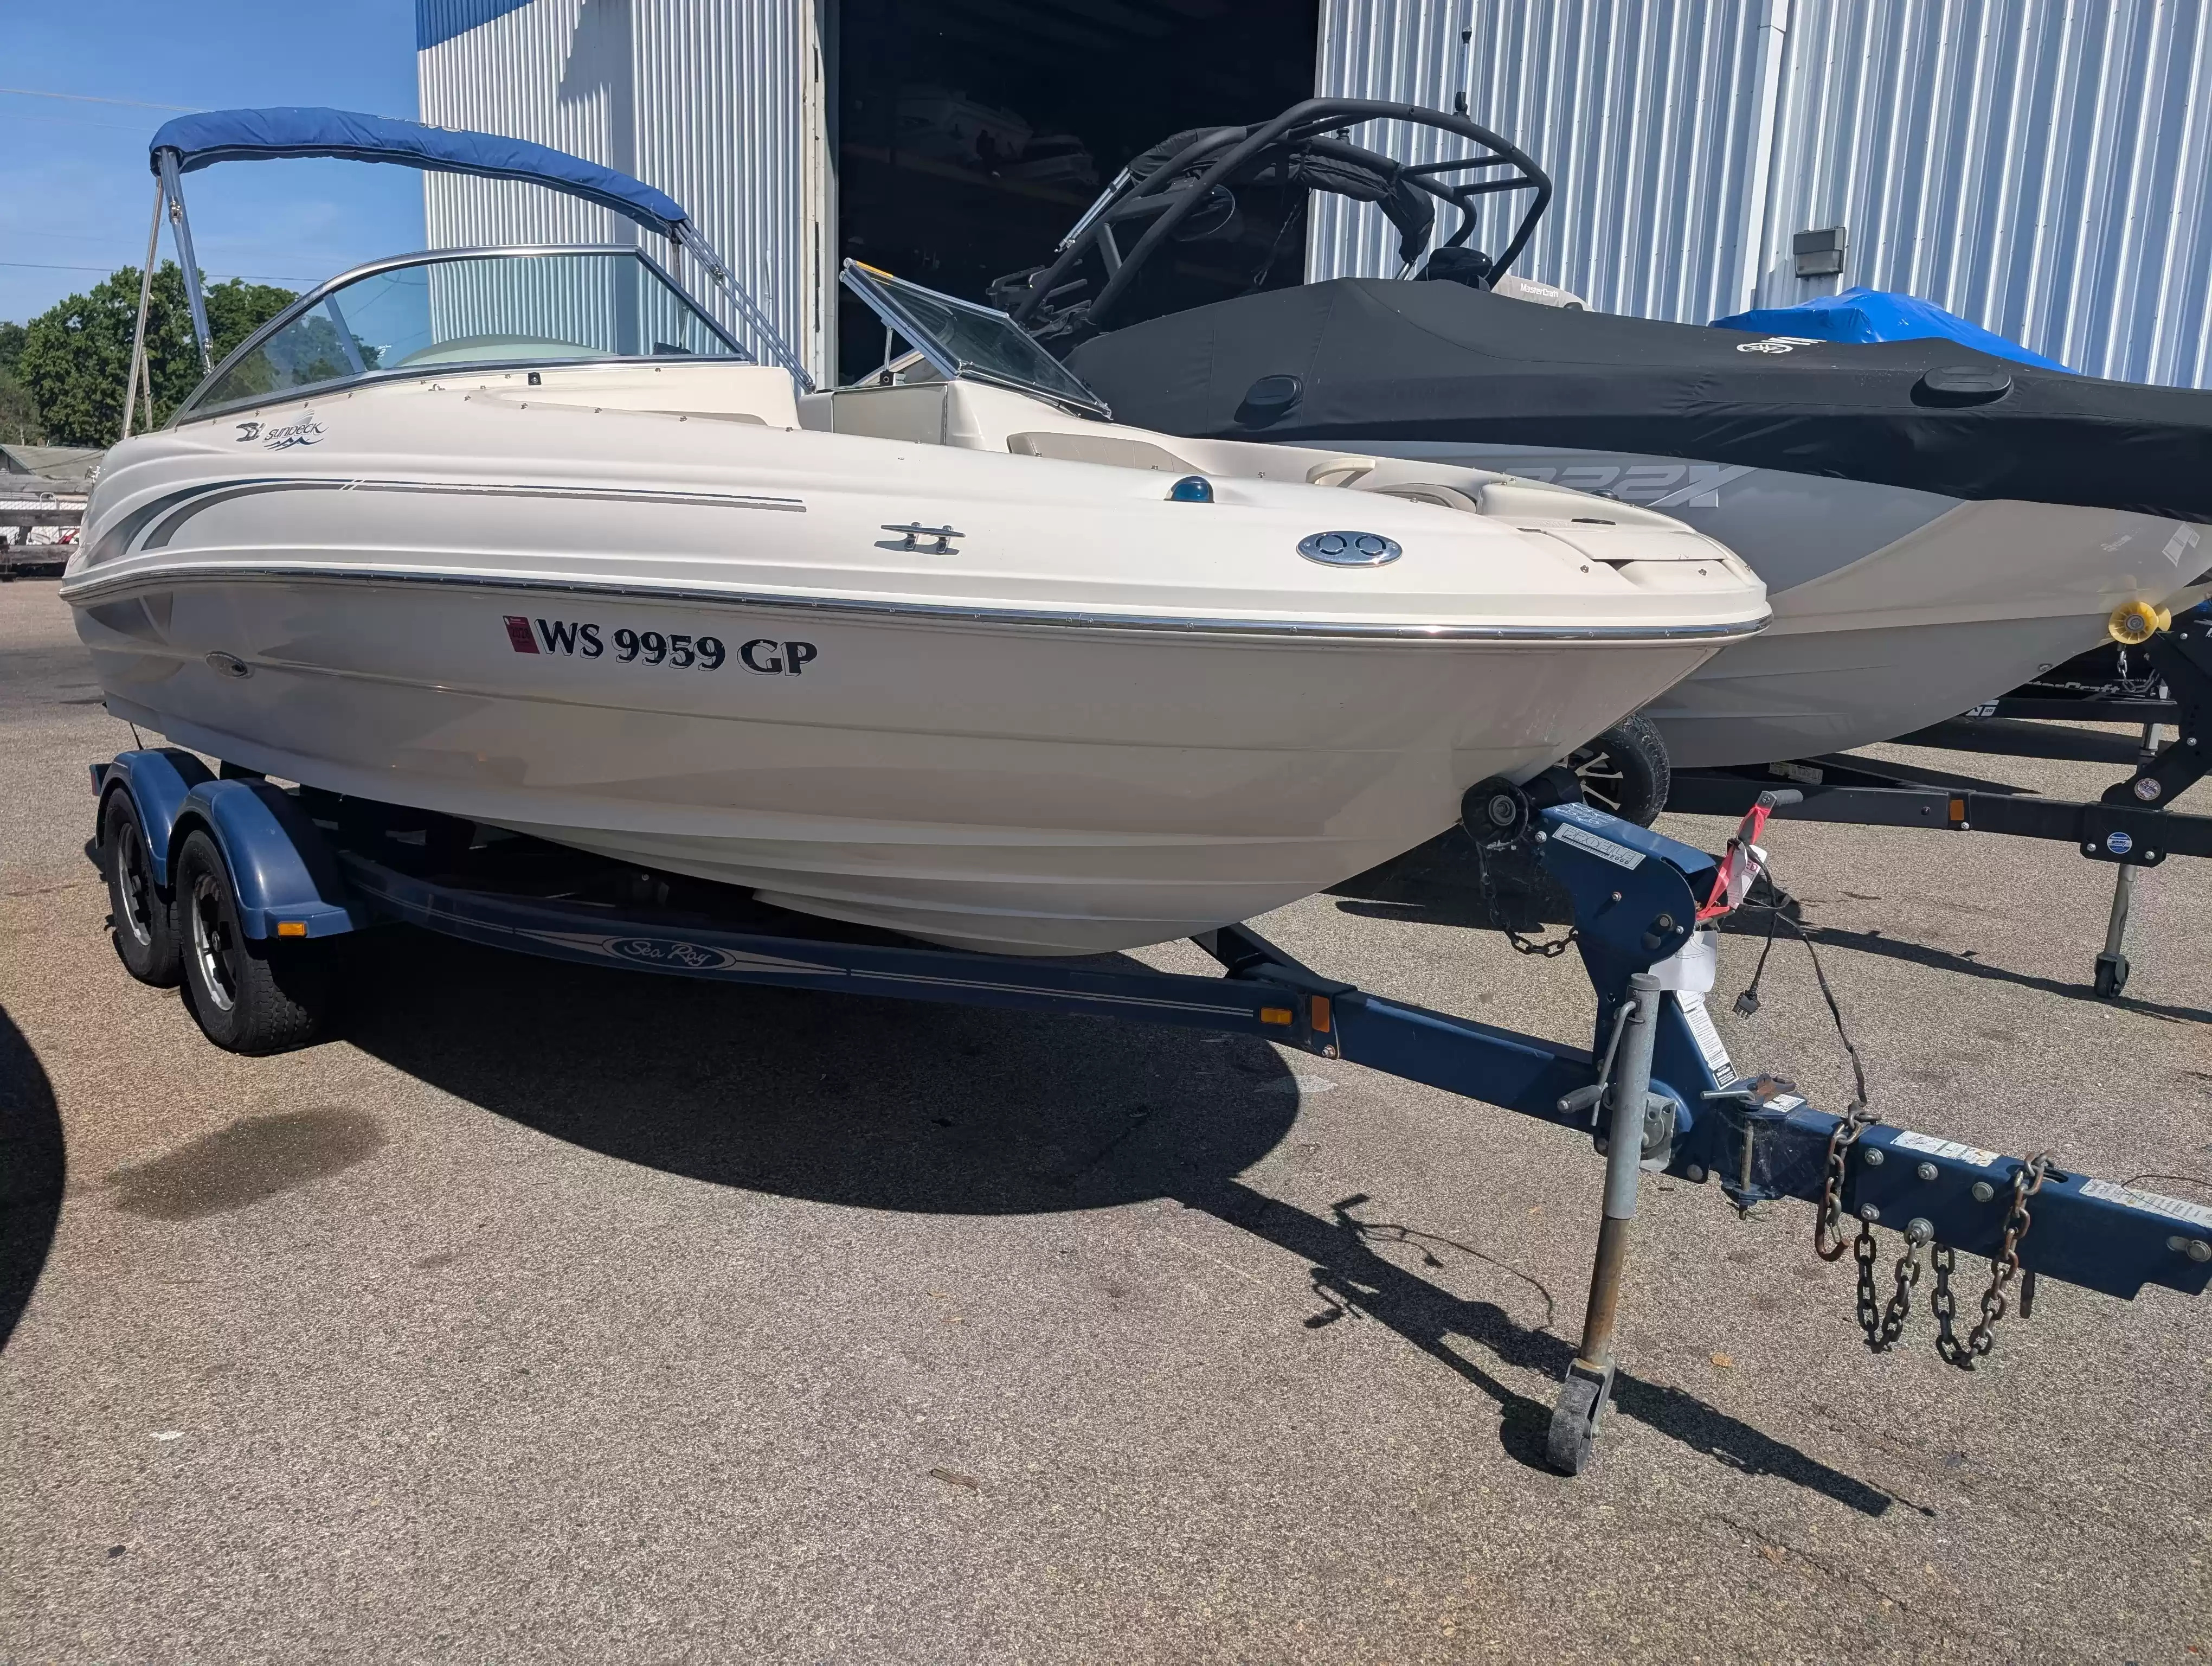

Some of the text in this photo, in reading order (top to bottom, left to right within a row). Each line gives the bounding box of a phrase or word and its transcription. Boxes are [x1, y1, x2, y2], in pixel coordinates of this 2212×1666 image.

[1520, 283, 1559, 298] MasterCraft
[534, 618, 818, 677] WS 9959 GP
[1562, 827, 1636, 863] PROFILE
[1609, 855, 1629, 865] 2000
[624, 940, 712, 967] Sea Ray
